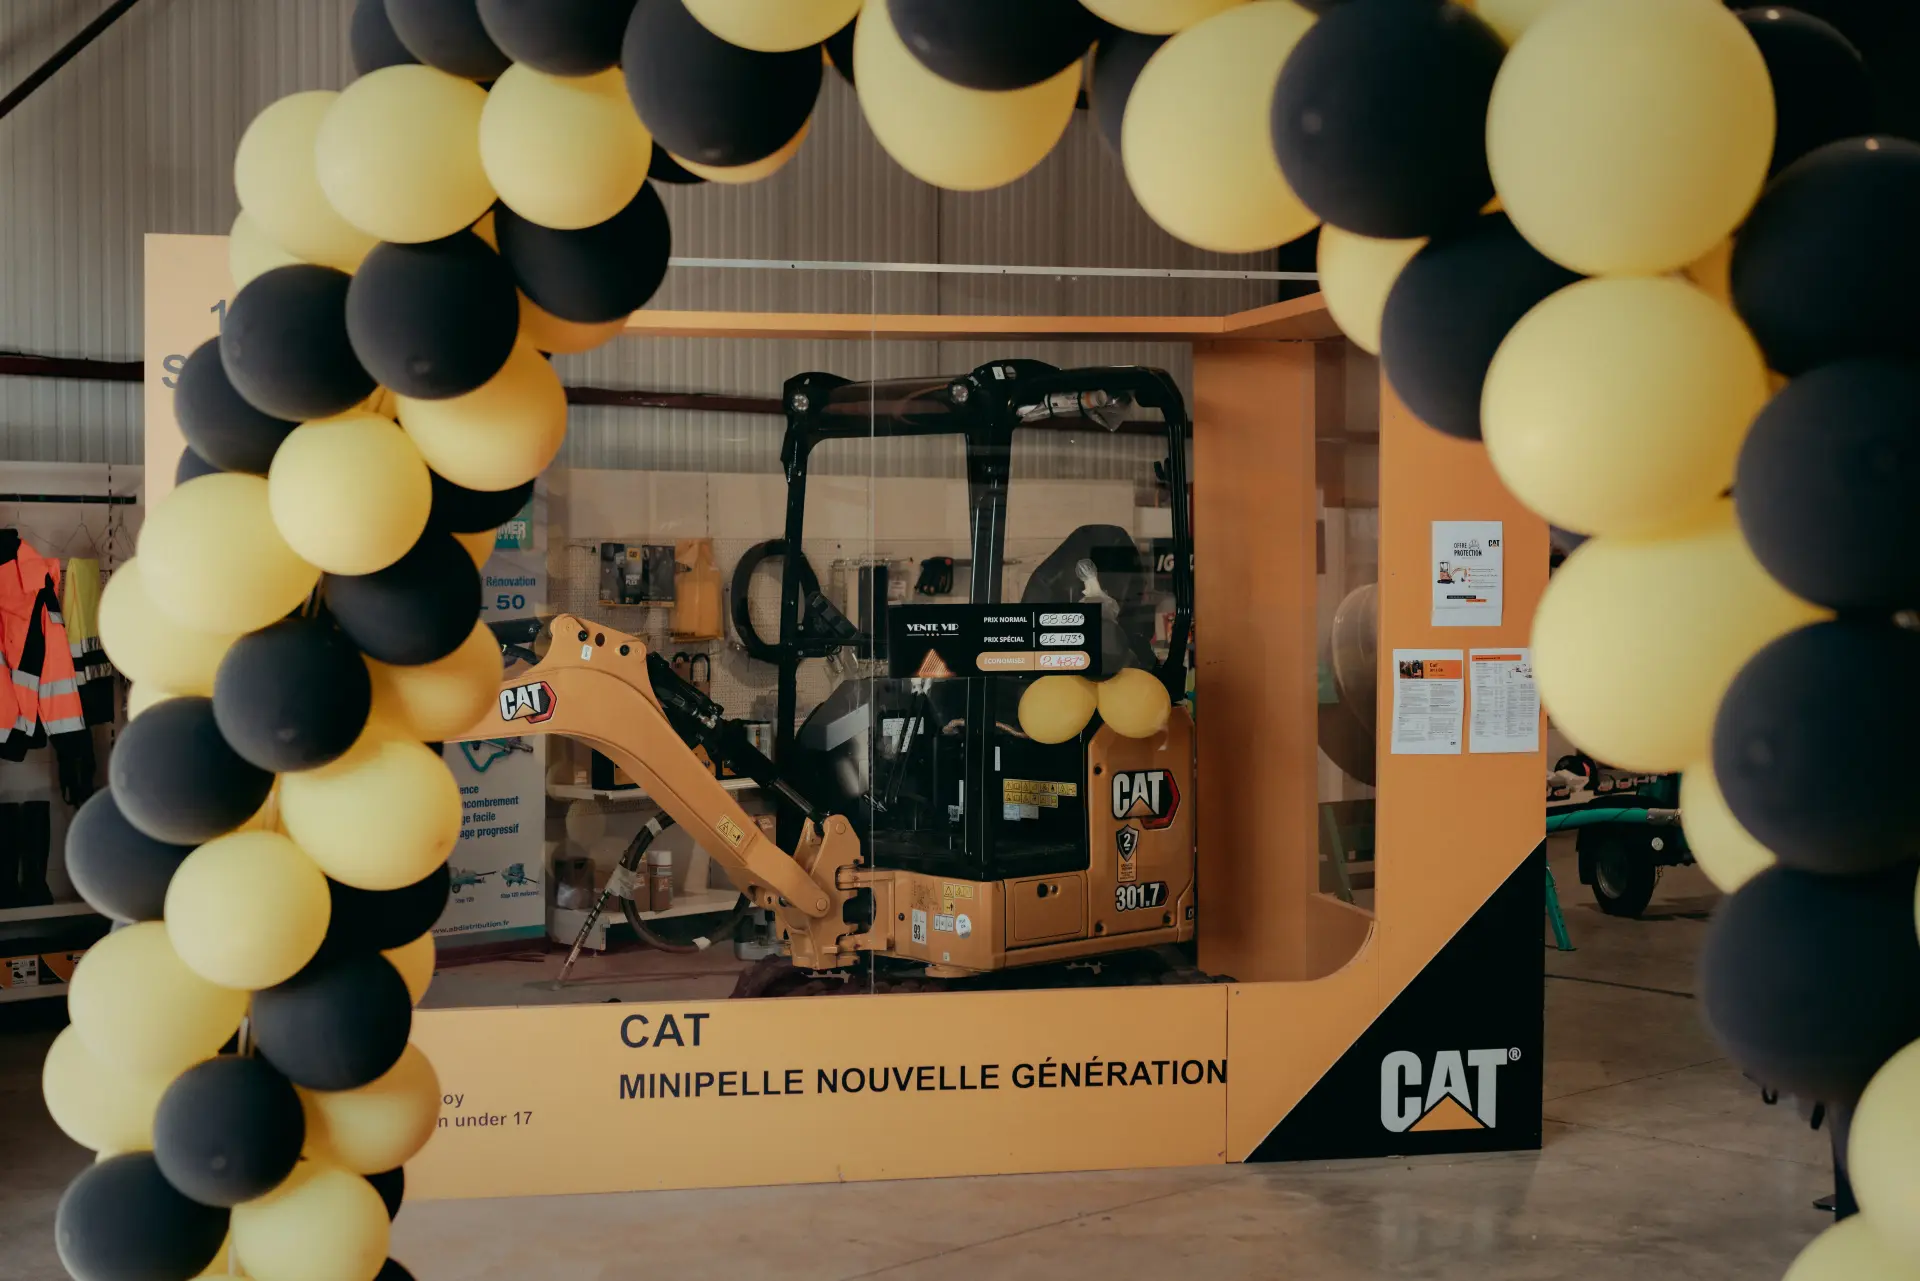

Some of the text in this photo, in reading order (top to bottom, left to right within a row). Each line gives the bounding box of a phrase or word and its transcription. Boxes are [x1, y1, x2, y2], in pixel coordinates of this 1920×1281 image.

[1488, 539, 1501, 548] CAT
[1454, 549, 1483, 557] PROTECTION
[486, 577, 536, 587] Rénovation
[496, 594, 526, 611] 50
[906, 623, 960, 632] VENTE VIP
[999, 635, 1025, 643] SPÉCIAL
[500, 683, 541, 721] CAT
[1112, 772, 1164, 819] CAT
[473, 812, 496, 823] facile
[477, 823, 519, 839] progressif
[1123, 833, 1131, 848] 2
[1116, 882, 1161, 911] 301.7
[620, 1012, 710, 1049] CAT
[619, 1056, 1227, 1100] MINIPELLE NOUVELLE GÉNÉRATION
[455, 1112, 507, 1127] under
[513, 1110, 533, 1126] 17
